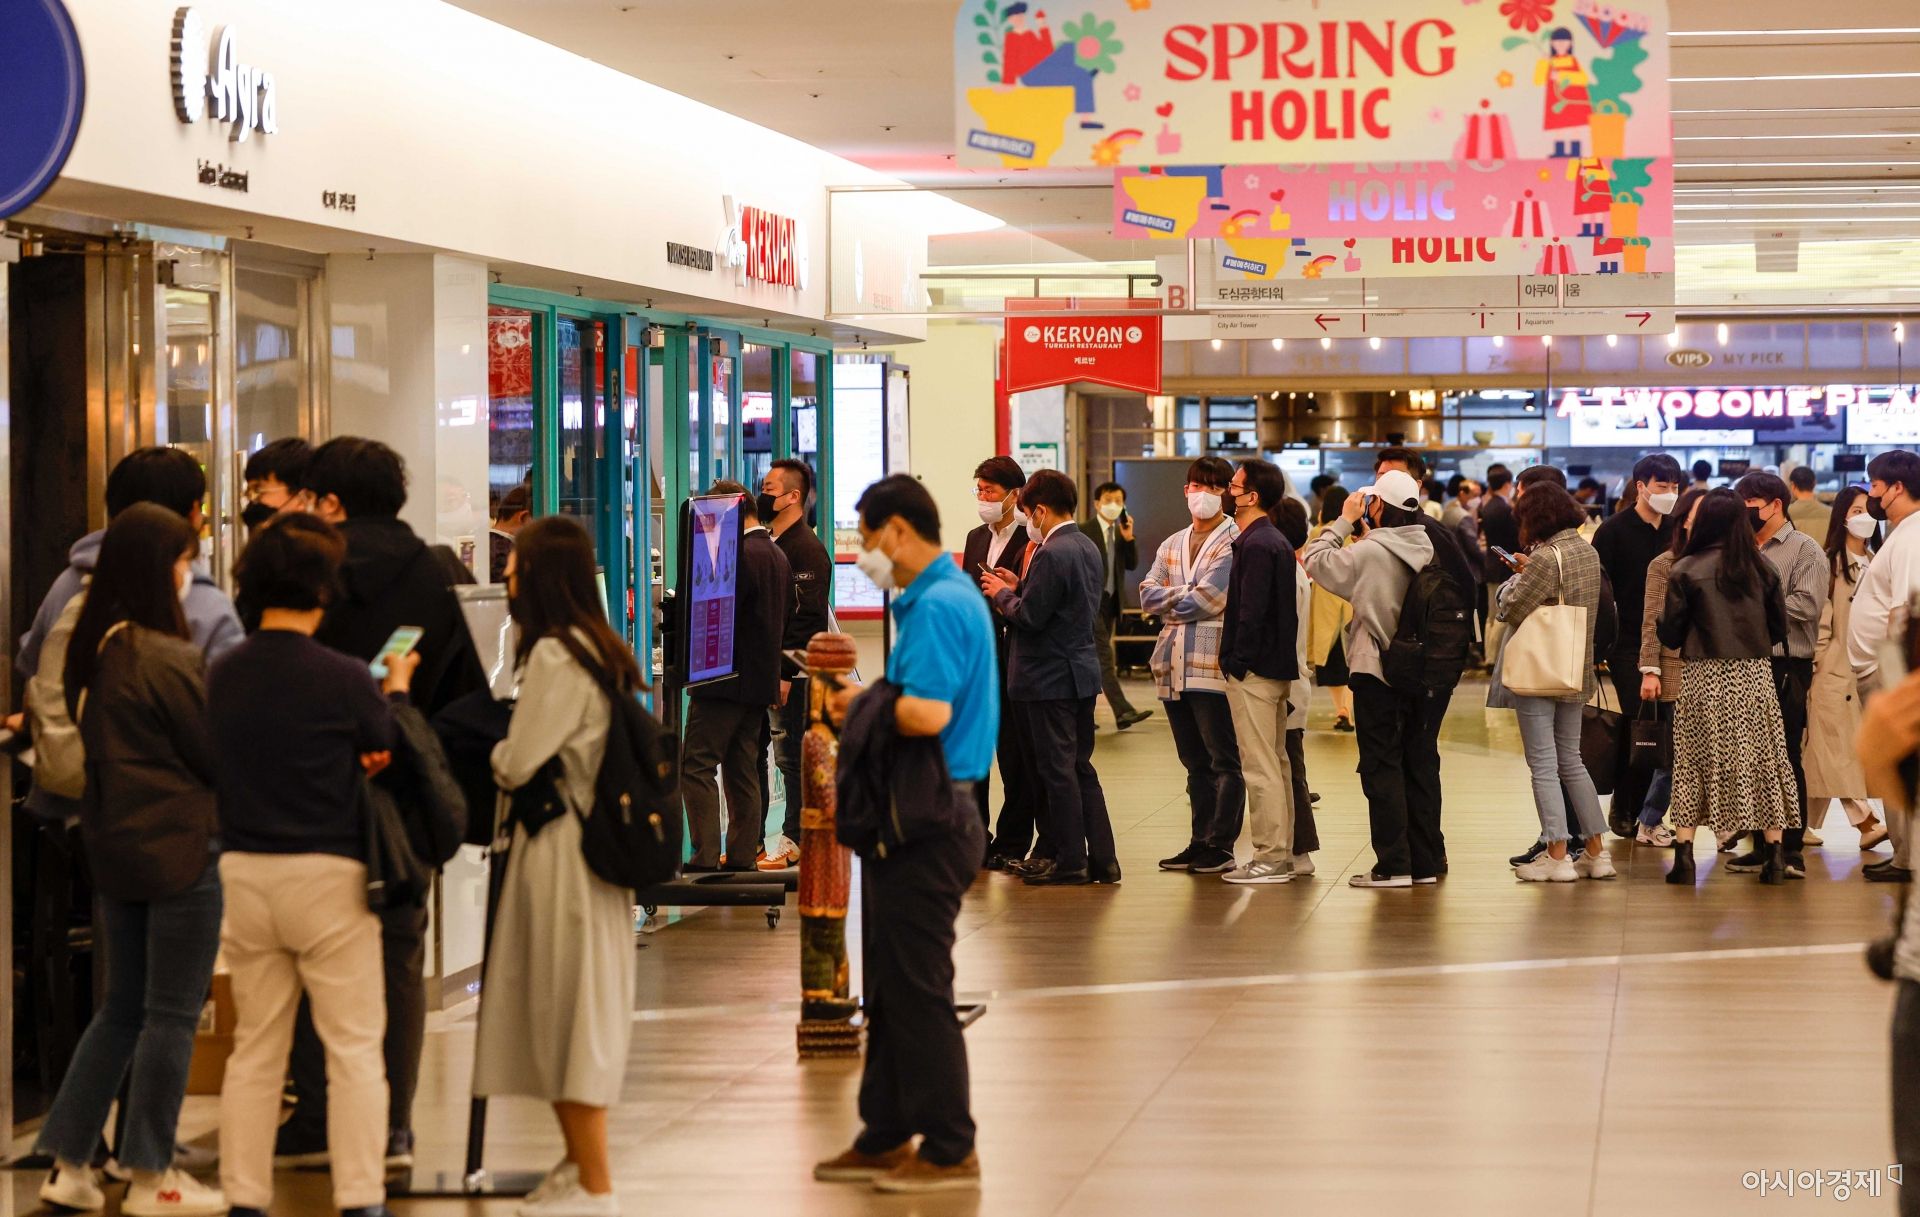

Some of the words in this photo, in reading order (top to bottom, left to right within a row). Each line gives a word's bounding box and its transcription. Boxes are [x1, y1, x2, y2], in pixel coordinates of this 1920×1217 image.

[1163, 18, 1456, 81] SPRING
[1231, 87, 1390, 141] HOLIC
[1327, 179, 1456, 222] HOLIC
[744, 206, 798, 290] KERVAN
[1392, 237, 1496, 263] HOLIC
[1168, 285, 1185, 308] B
[1218, 287, 1284, 301] 도심공항타워
[1043, 326, 1123, 343] KERVAN
[1217, 322, 1228, 330] City
[1074, 356, 1096, 365] 케르반
[1676, 353, 1703, 365] VIPS
[1723, 353, 1744, 365] MY
[1751, 352, 1784, 365] PICK
[1557, 391, 1583, 417] A
[1592, 386, 1813, 417] TWOSOME
[1825, 385, 1920, 417] PLA
